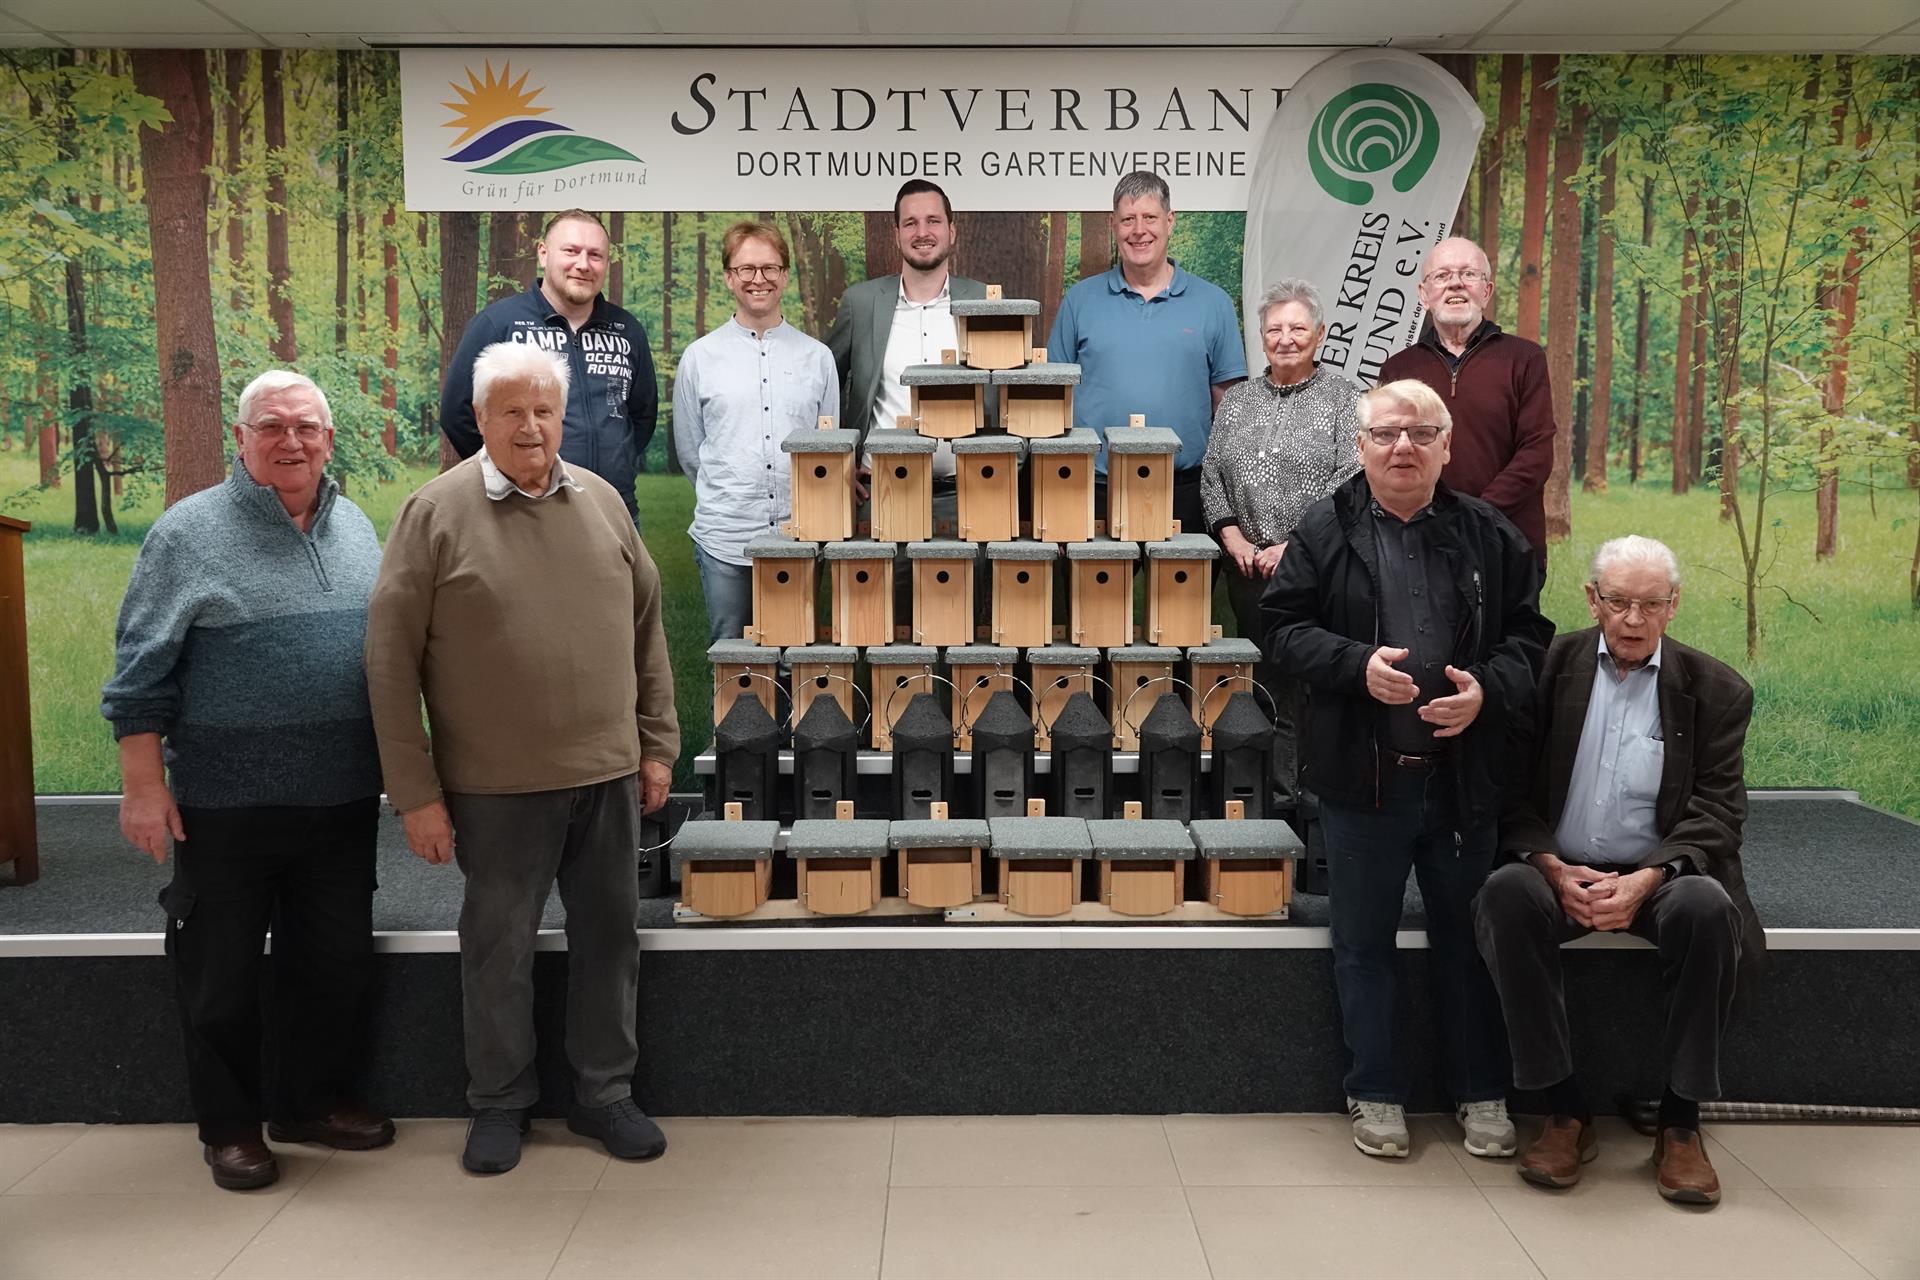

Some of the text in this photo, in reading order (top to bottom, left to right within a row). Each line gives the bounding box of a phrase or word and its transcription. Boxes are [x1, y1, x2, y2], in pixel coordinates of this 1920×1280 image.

[737, 151, 1246, 176] DORTMUNDER GARTENVEREINE
[462, 168, 648, 204] Grün für Dortmund
[1336, 212, 1390, 313] KREIS
[1395, 218, 1430, 277] e.V.
[511, 330, 631, 356] CAMP DAVID
[585, 352, 629, 366] OCEAN
